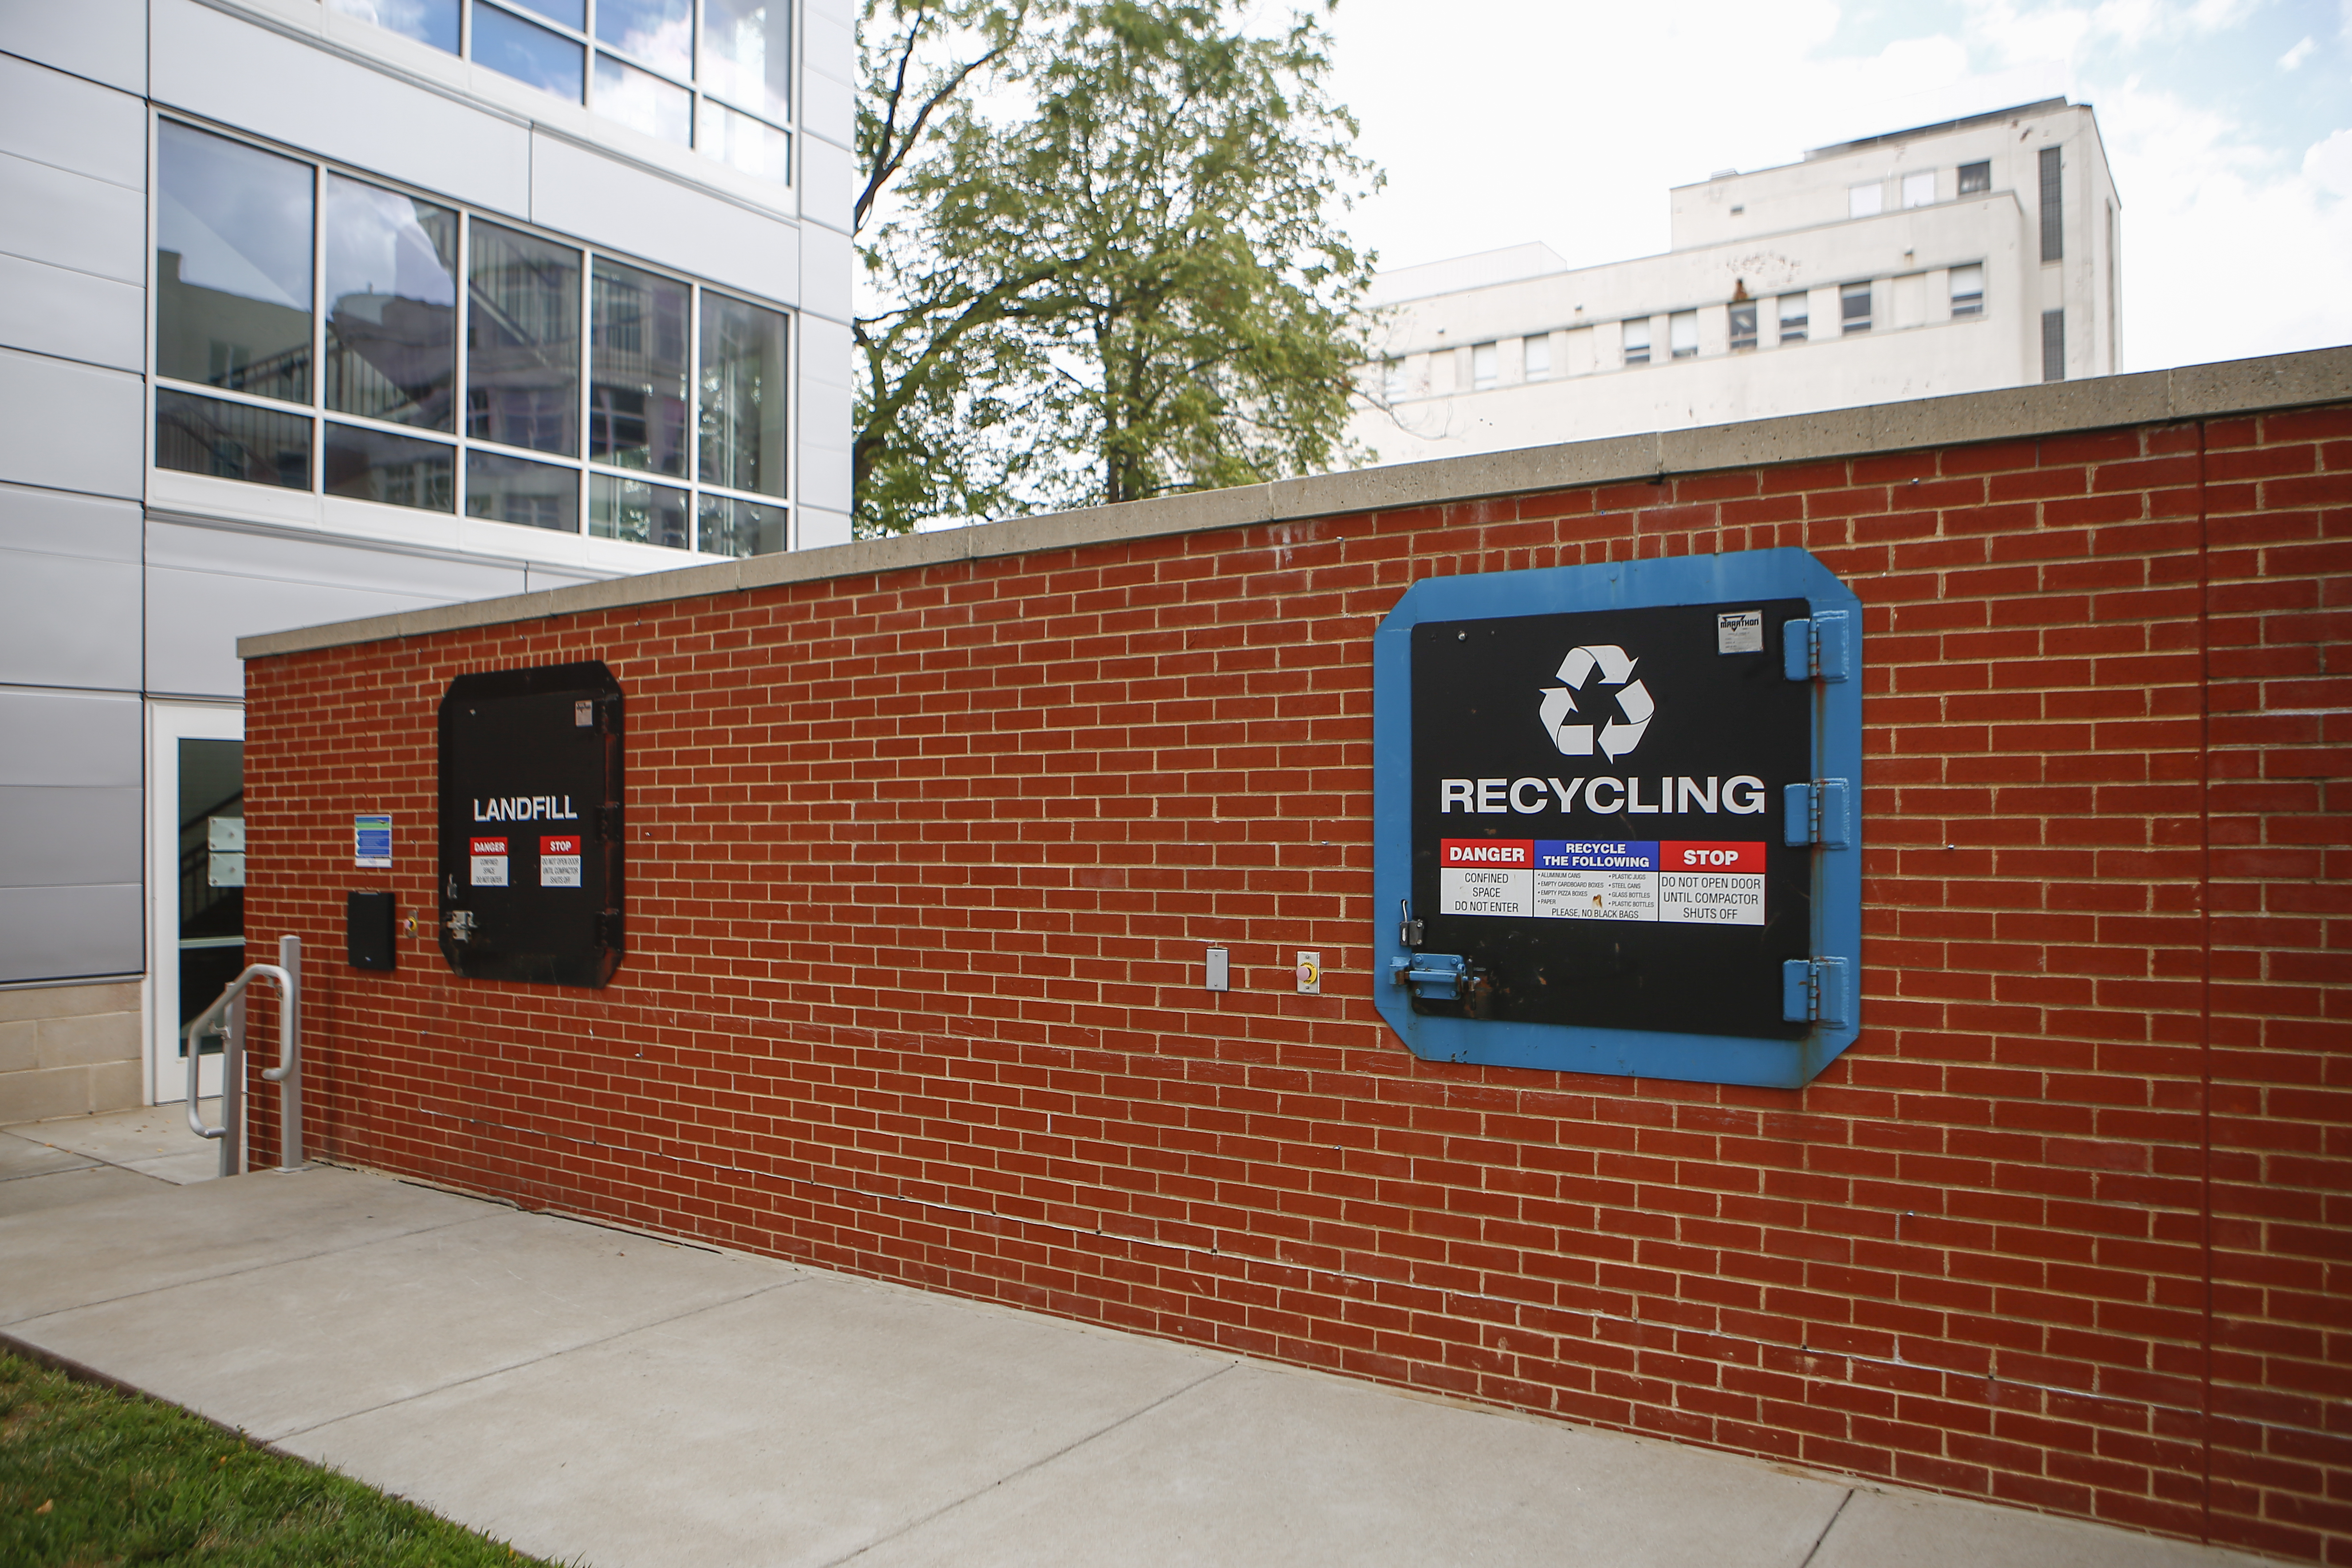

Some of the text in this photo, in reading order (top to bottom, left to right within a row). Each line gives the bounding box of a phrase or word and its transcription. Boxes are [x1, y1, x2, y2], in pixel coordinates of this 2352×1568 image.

[1721, 618, 1759, 628] MARATHON
[1442, 775, 1765, 813] RECYCLING
[473, 795, 578, 821] LANDFILL
[474, 841, 506, 853] DANGER
[550, 841, 572, 852] STOP
[1565, 843, 1626, 854] RECYCLE
[1450, 847, 1525, 862] DANGER
[1683, 849, 1738, 865] STOP
[1543, 856, 1649, 868] THE FOLLOWING
[1465, 872, 1508, 883] CONFINED
[1662, 876, 1760, 889] DO NOT OPEN DOOR
[1473, 887, 1500, 897] SPACE
[1664, 892, 1758, 904] UNTIL COMPACTOR
[1455, 901, 1518, 912] DO NOT ENTER
[1552, 908, 1580, 917] PLEASE,
[1594, 909, 1617, 918] BLACK
[1683, 907, 1738, 919] SHUTS OFF
